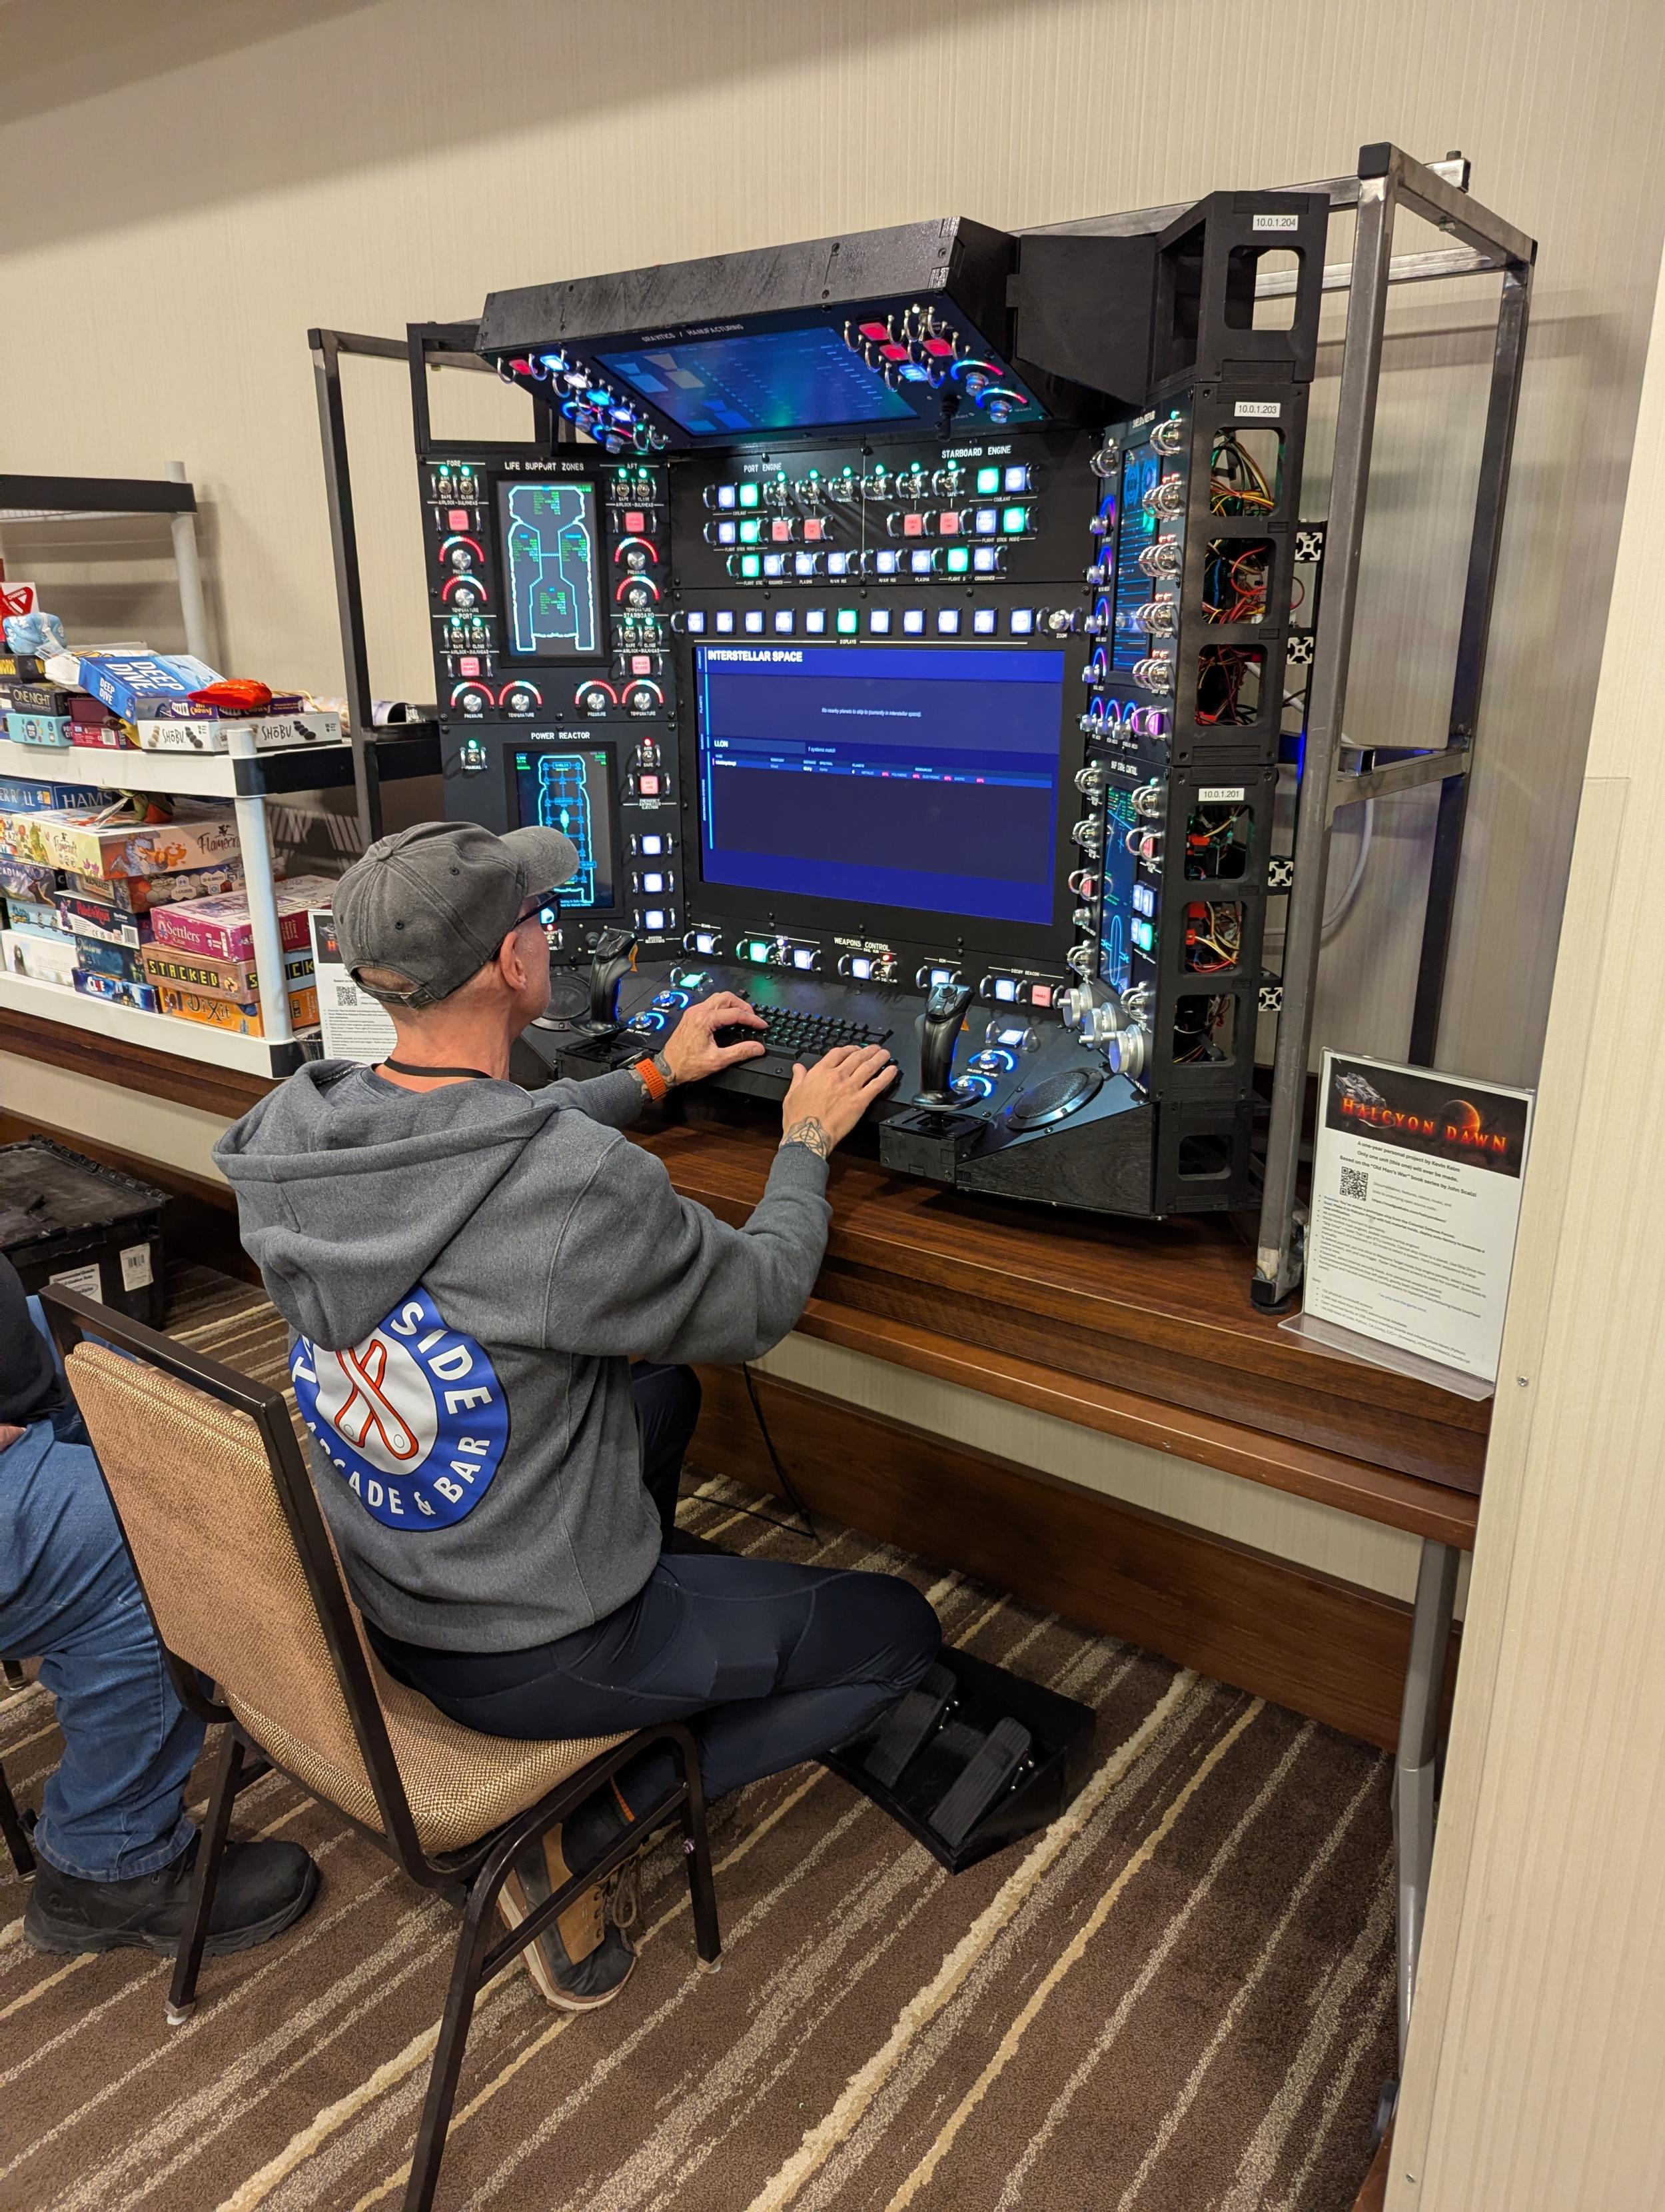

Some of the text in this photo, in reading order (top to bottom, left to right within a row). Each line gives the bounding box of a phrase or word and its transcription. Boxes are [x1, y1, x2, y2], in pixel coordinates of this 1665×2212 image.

[1256, 218, 1297, 227] 10.0.1.204
[686, 323, 744, 336] MANUFACTURING
[1237, 405, 1277, 415] 10.0.1.203
[941, 445, 1012, 459] STARBOARD ENGINE
[504, 461, 584, 471] LIFE SUPPORT ZONES
[744, 462, 782, 473] PORT ENGINE
[708, 650, 803, 662] INTERSTELLAR SPACE
[105, 662, 157, 691] DIVE
[129, 660, 185, 692] DEEP
[100, 677, 115, 694] DEEP
[13, 690, 51, 706] ONE NIGHT
[99, 690, 113, 705] DIVE
[558, 731, 590, 740] REACTOR
[1203, 790, 1239, 799] 10.0.1.201
[167, 922, 201, 944] Settlers
[833, 936, 891, 952] WEAPONS CONTROL
[149, 959, 220, 988] STACKED
[87, 976, 105, 992] CLUE
[1342, 1097, 1508, 1153] HALCYON DAWN
[390, 1301, 493, 1415] SIDE
[432, 1436, 491, 1504] BAR
[413, 1491, 436, 1516] &
